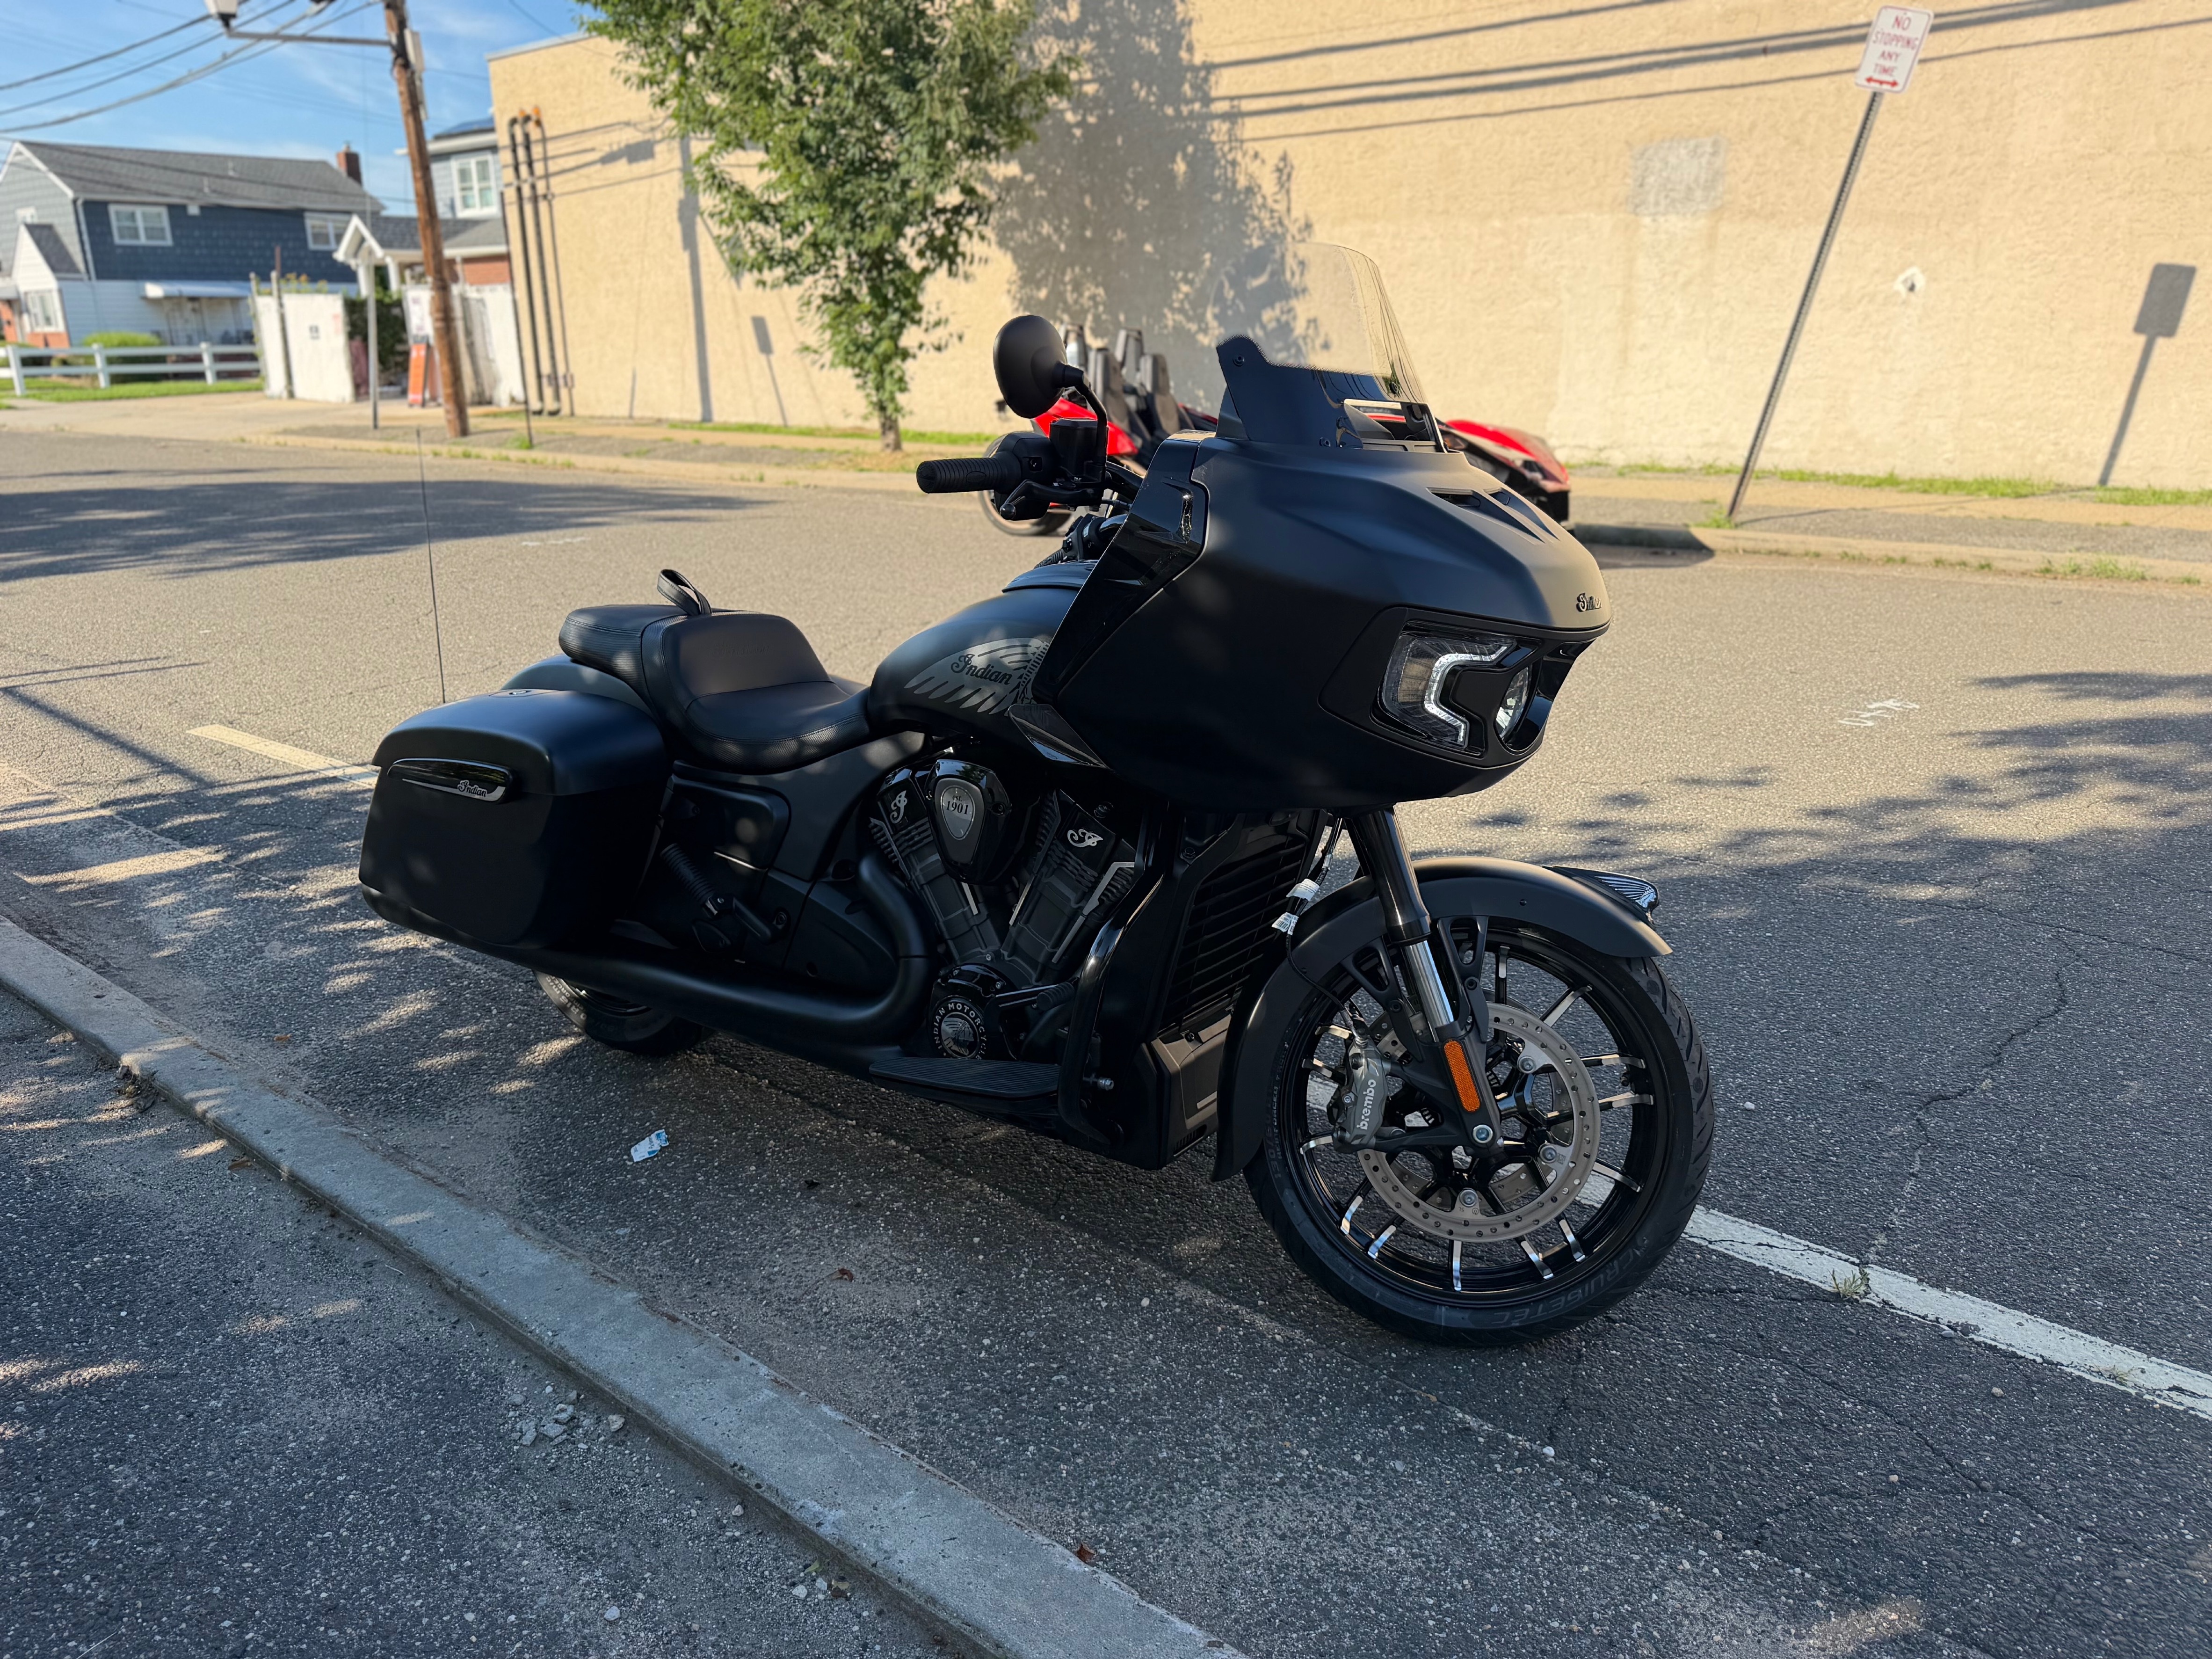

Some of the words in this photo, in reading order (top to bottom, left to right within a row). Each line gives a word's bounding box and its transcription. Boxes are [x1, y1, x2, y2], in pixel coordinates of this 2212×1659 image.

[1892, 15, 1911, 30] NO
[1879, 50, 1901, 62] ANY
[1874, 63, 1897, 76] TIME
[950, 654, 1013, 685] Indian
[458, 780, 487, 797] Indian
[947, 801, 969, 815] 1901
[934, 1007, 945, 1049] INDIAN
[948, 1003, 987, 1060] MOTORCYCLE
[1356, 1079, 1376, 1130] brembo
[1491, 1248, 1634, 1324] CRUISETEC
